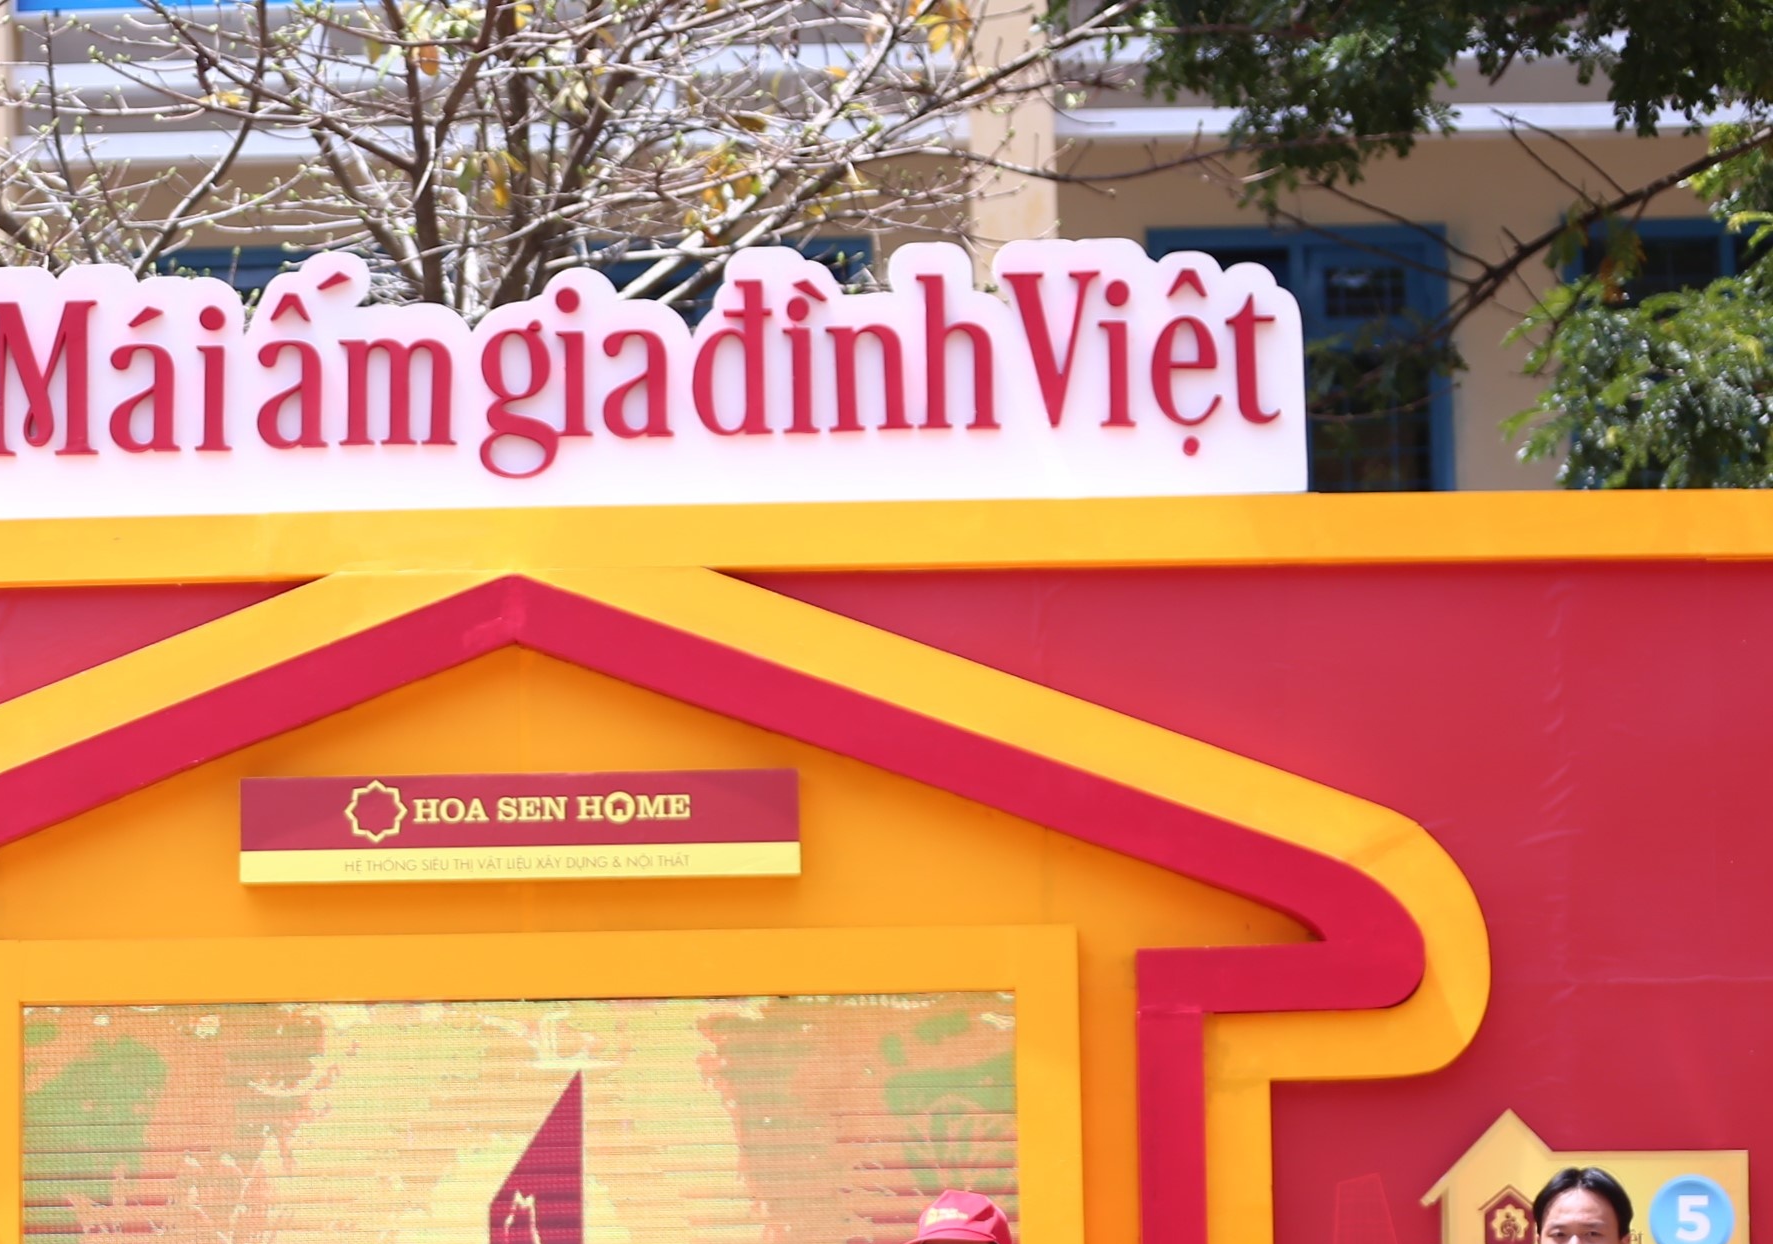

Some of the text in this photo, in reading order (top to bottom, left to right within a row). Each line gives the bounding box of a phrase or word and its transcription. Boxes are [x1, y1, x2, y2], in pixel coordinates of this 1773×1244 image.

[255, 271, 458, 450] ấm
[477, 287, 676, 479] gia
[690, 274, 1000, 437] đình
[1002, 268, 1280, 458] Việt
[413, 791, 691, 824] HOA SEN HOME
[612, 855, 622, 868] &
[1675, 1194, 1711, 1242] 5
